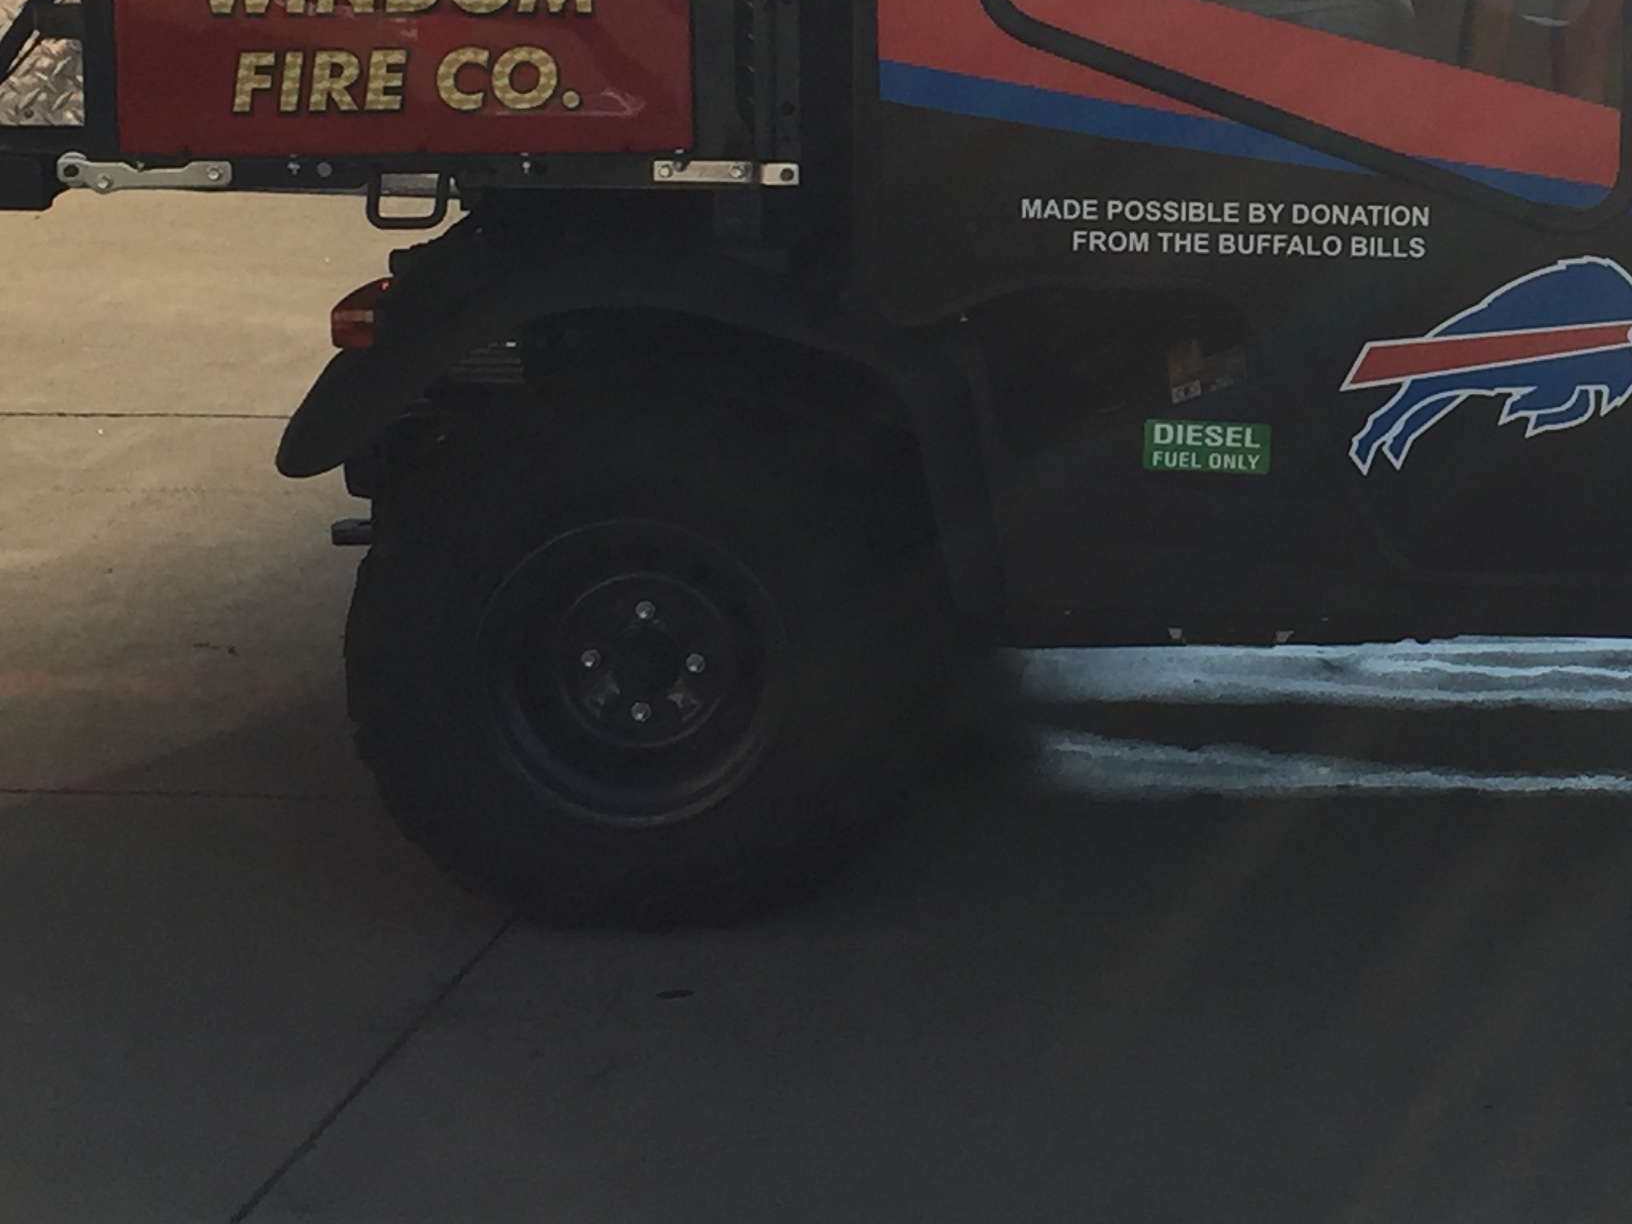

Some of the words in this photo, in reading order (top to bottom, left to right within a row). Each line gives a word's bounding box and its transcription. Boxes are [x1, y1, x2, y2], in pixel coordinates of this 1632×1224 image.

[232, 48, 409, 113] FIRE
[435, 45, 582, 111] CO.
[1021, 198, 1099, 220] MADE
[1107, 200, 1240, 223] POSSIBLE
[1249, 203, 1285, 223] BY
[1292, 203, 1430, 227] DONATION
[1072, 230, 1150, 253] FROM
[1157, 232, 1210, 254] THE
[1218, 233, 1343, 257] BUFFALO
[1351, 236, 1427, 258] BILLS
[1153, 423, 1261, 449] DIESEL
[1152, 450, 1202, 469] FUEL
[1208, 452, 1261, 471] ONLY
